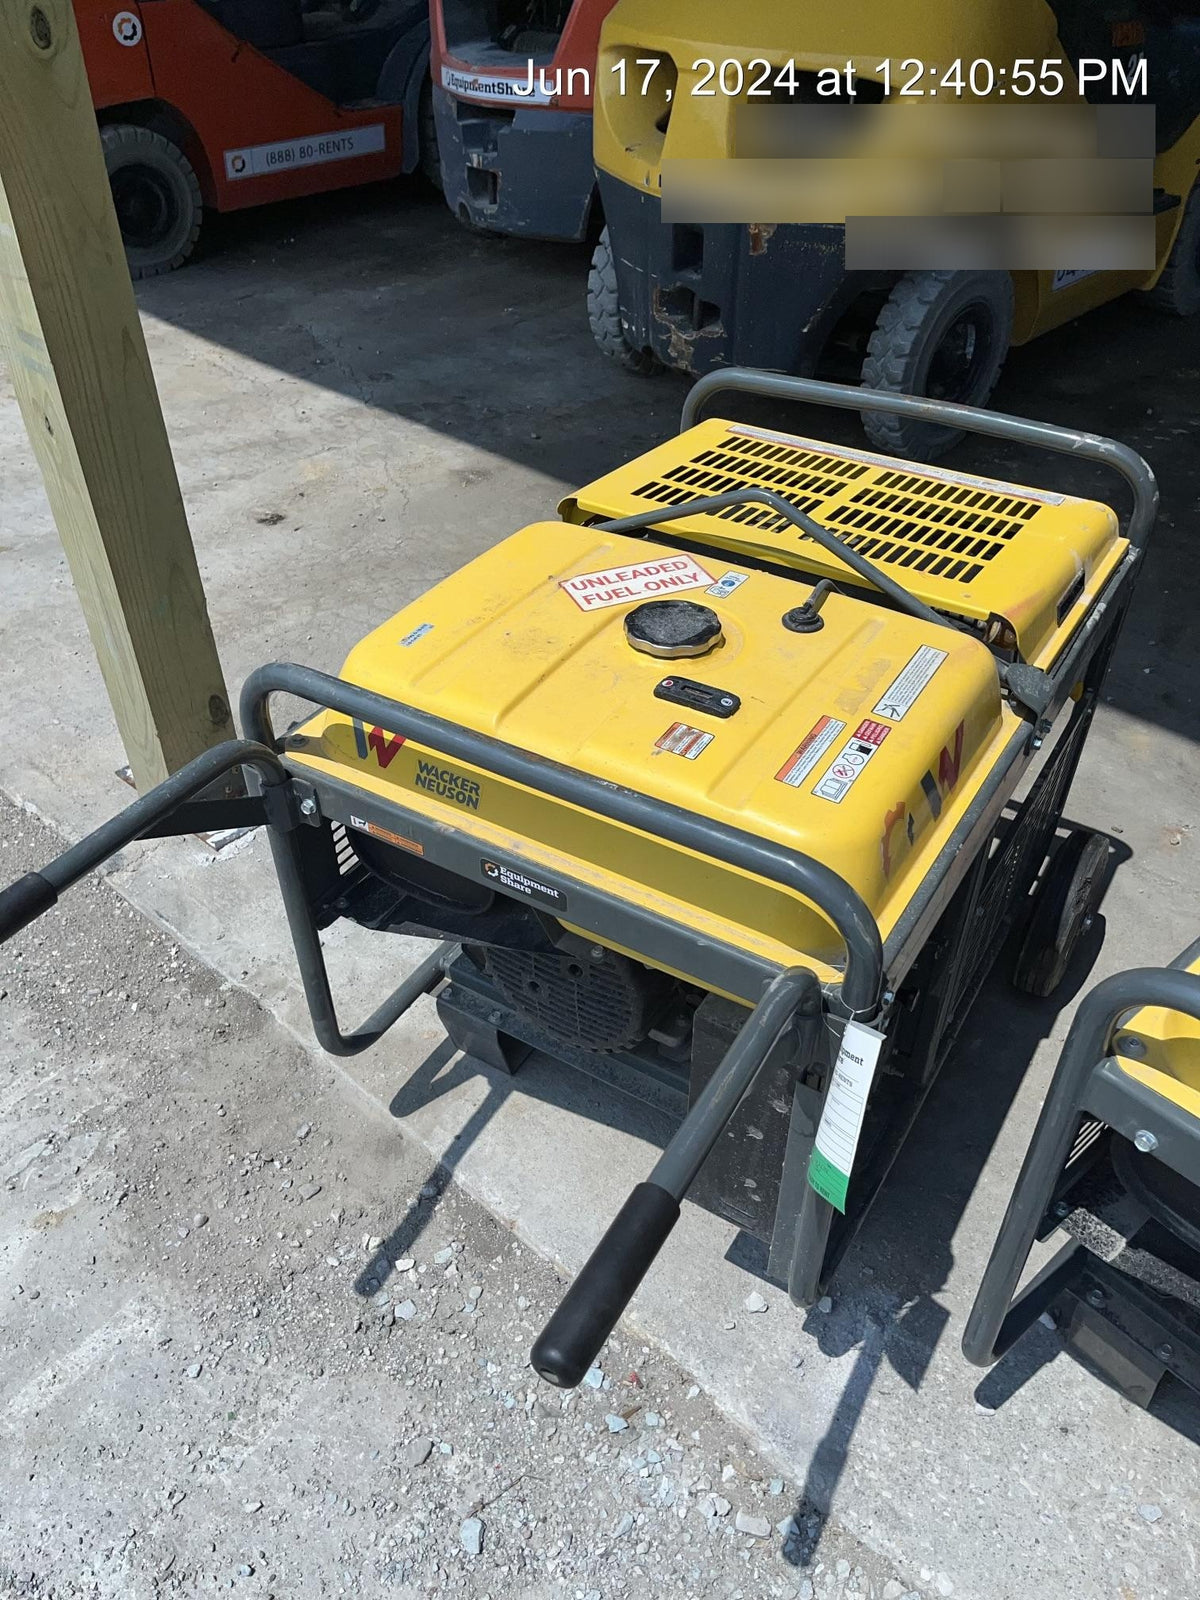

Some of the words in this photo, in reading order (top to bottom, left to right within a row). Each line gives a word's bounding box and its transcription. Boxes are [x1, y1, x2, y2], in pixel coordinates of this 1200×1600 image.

[265, 148, 296, 167] (888)
[299, 137, 354, 159] 80-RENTS
[570, 561, 688, 591] UNLEADED
[582, 586, 641, 606] FUEL
[644, 572, 700, 592] ONLY
[415, 773, 480, 810] NEUSON
[417, 760, 480, 796] WACKER
[499, 866, 560, 899] Equipment
[500, 875, 532, 895] Share
